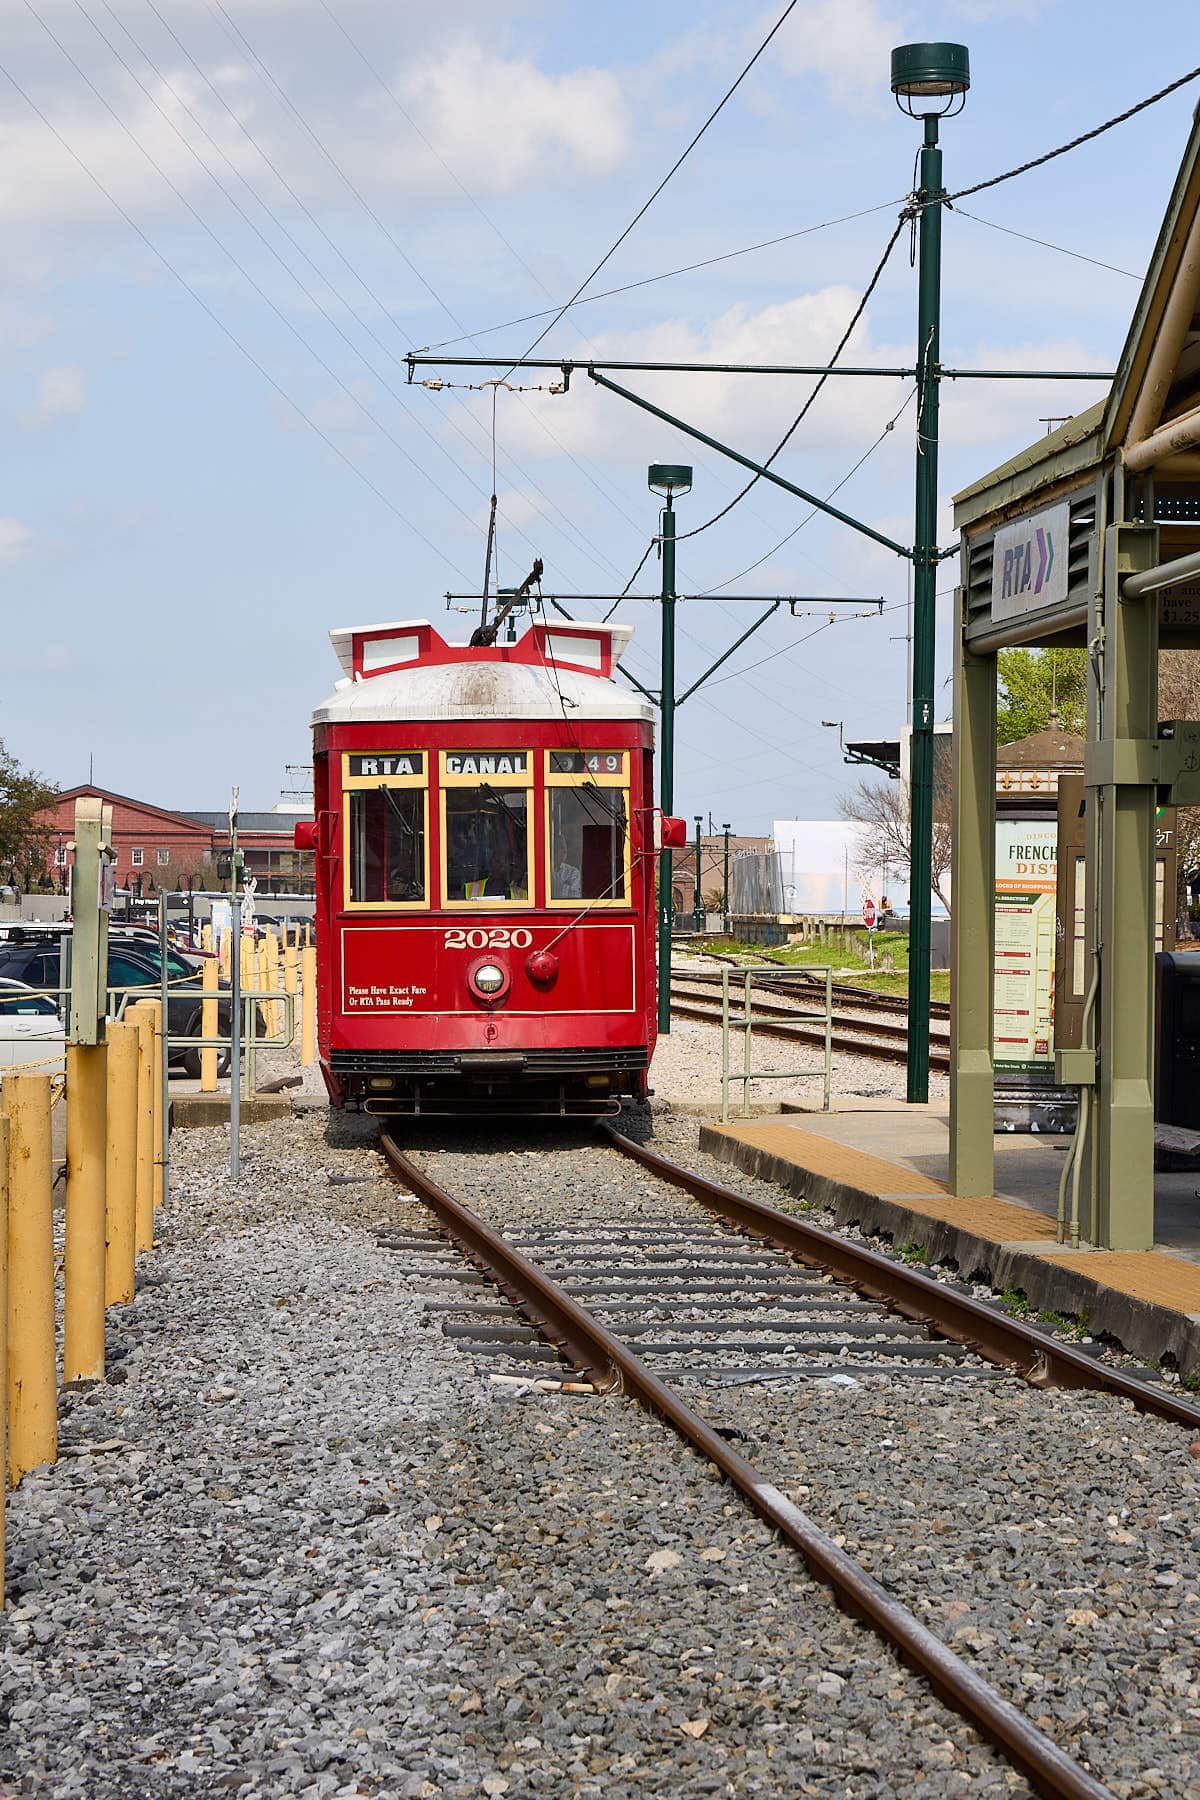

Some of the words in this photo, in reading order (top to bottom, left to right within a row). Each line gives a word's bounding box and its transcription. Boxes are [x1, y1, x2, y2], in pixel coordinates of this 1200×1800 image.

[1001, 541, 1031, 599] RTA
[1163, 596, 1192, 608] have
[361, 757, 414, 775] RTA
[446, 756, 527, 774] CANAL
[1009, 845, 1057, 861] FRENCH
[444, 929, 533, 949] 2020
[349, 986, 369, 995] Please
[371, 986, 387, 995] Have
[389, 986, 409, 995] Exact
[411, 986, 427, 994] Fare
[349, 997, 358, 1006] Or
[360, 997, 374, 1006] RTA
[376, 997, 390, 1006] Pass
[392, 997, 413, 1007] Ready
